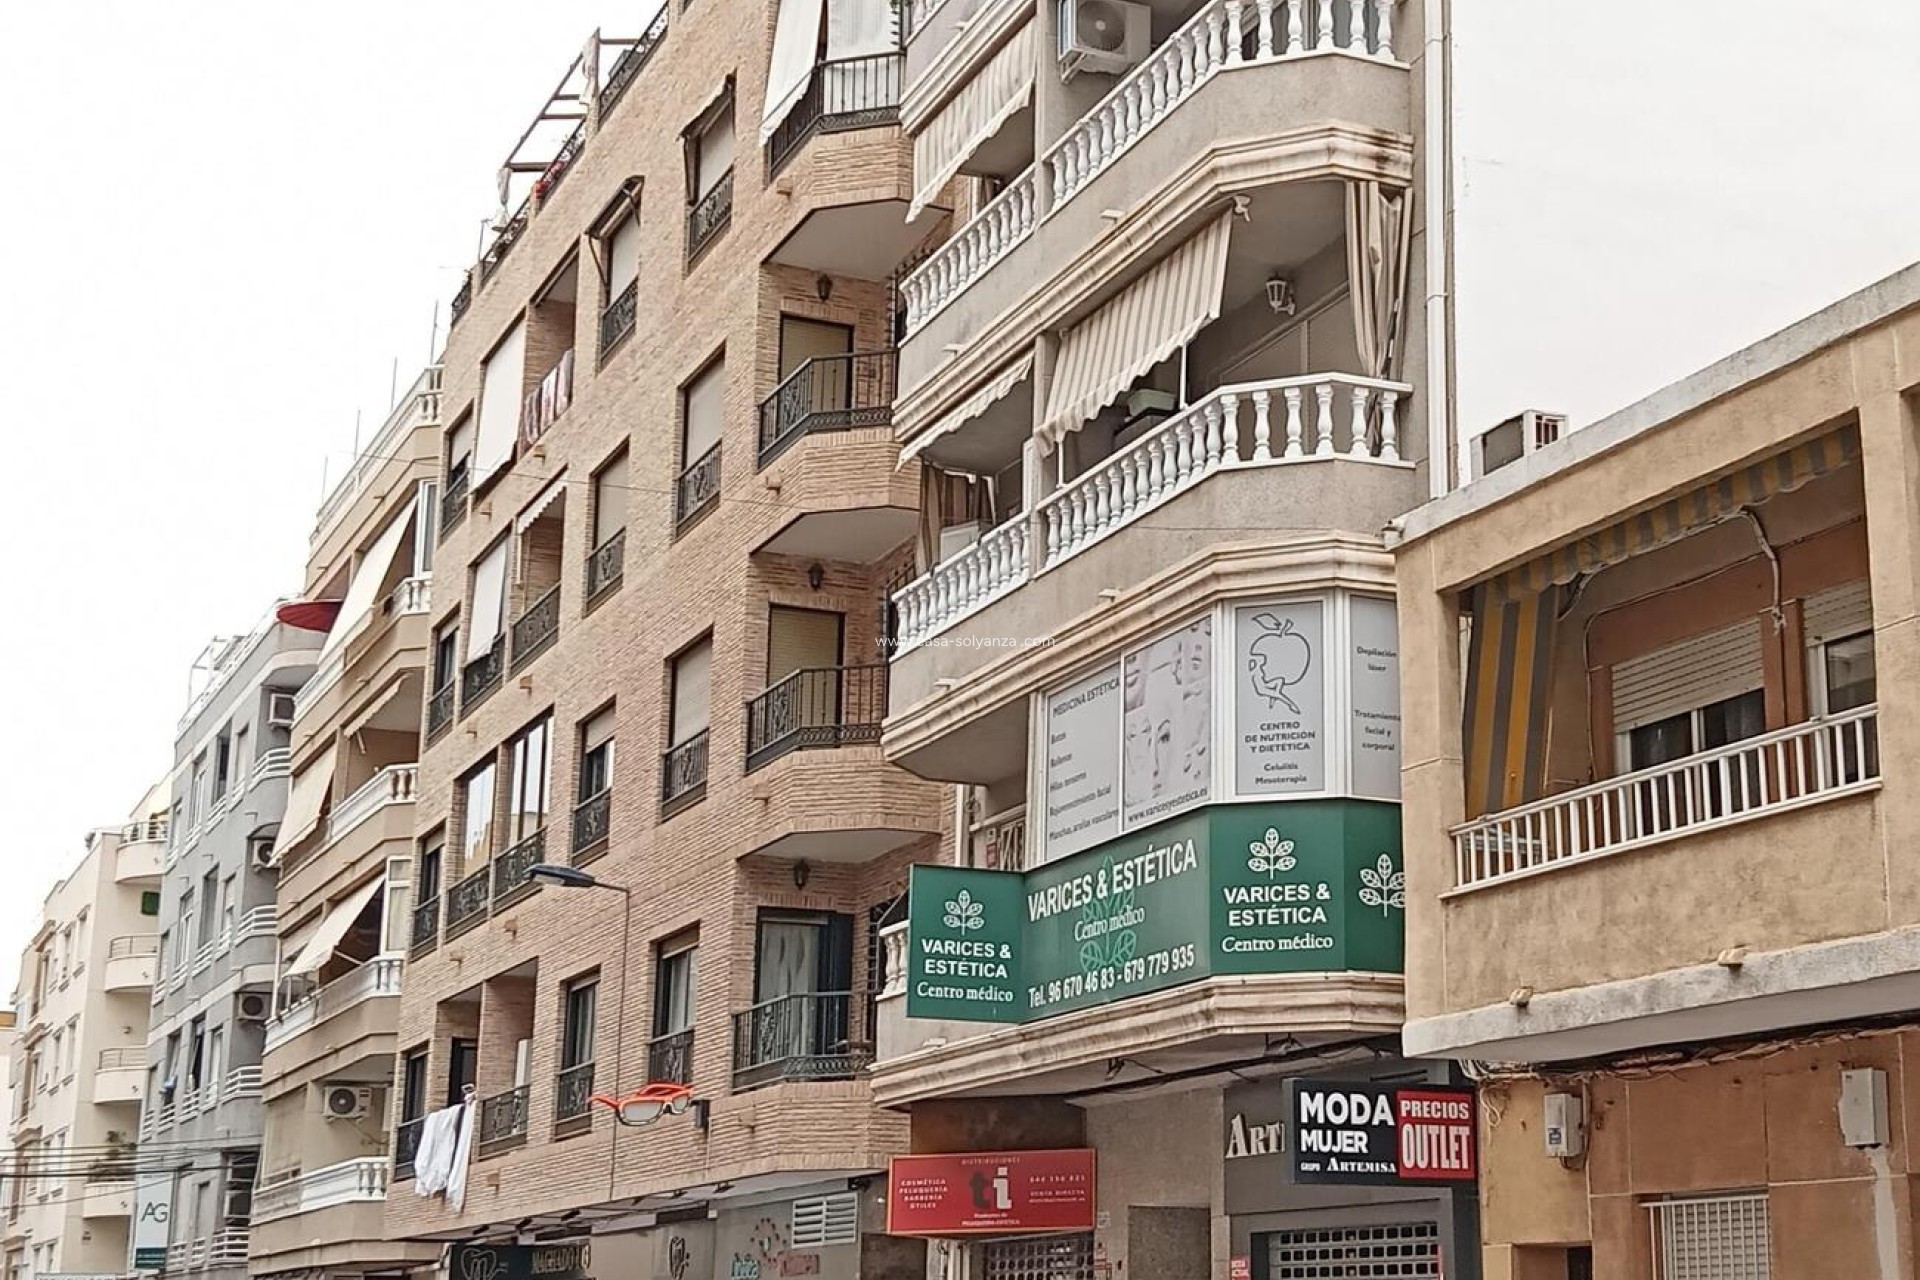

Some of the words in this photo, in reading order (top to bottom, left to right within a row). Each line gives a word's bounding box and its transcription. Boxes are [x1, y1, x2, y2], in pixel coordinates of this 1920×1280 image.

[1260, 721, 1301, 731] CENTRO
[1245, 734, 1258, 743] DE
[1028, 874, 1093, 922] VARICES
[1096, 869, 1109, 900] &
[1112, 839, 1198, 894] ESTÉTICA
[1223, 884, 1311, 904] VARICES
[1316, 883, 1331, 900] &
[1074, 918, 1107, 942] Centro
[1108, 905, 1146, 933] médico
[1228, 904, 1327, 927] ESTÉTICA
[921, 938, 995, 958] VARICES
[999, 944, 1012, 959] &
[1222, 936, 1275, 953] Centro
[1278, 932, 1334, 950] médico
[924, 957, 1008, 979] ESTÉTICA
[1028, 985, 1047, 1009] Tel.
[1048, 980, 1062, 1004] 96
[1062, 975, 1082, 999] 670
[1084, 971, 1099, 994] 46
[1101, 966, 1116, 990] 83
[1123, 957, 1146, 983] 679
[1147, 951, 1170, 977] 779
[1171, 944, 1195, 971] 935
[916, 981, 964, 999] Centro
[965, 985, 1014, 1002] médico
[1300, 1091, 1395, 1126] MODA
[1400, 1100, 1470, 1119] PRECIOS
[1300, 1129, 1369, 1154] MUJER
[1402, 1124, 1471, 1170] OUTLET
[1326, 1157, 1397, 1173] ARTEMISA
[141, 1202, 169, 1223] AG
